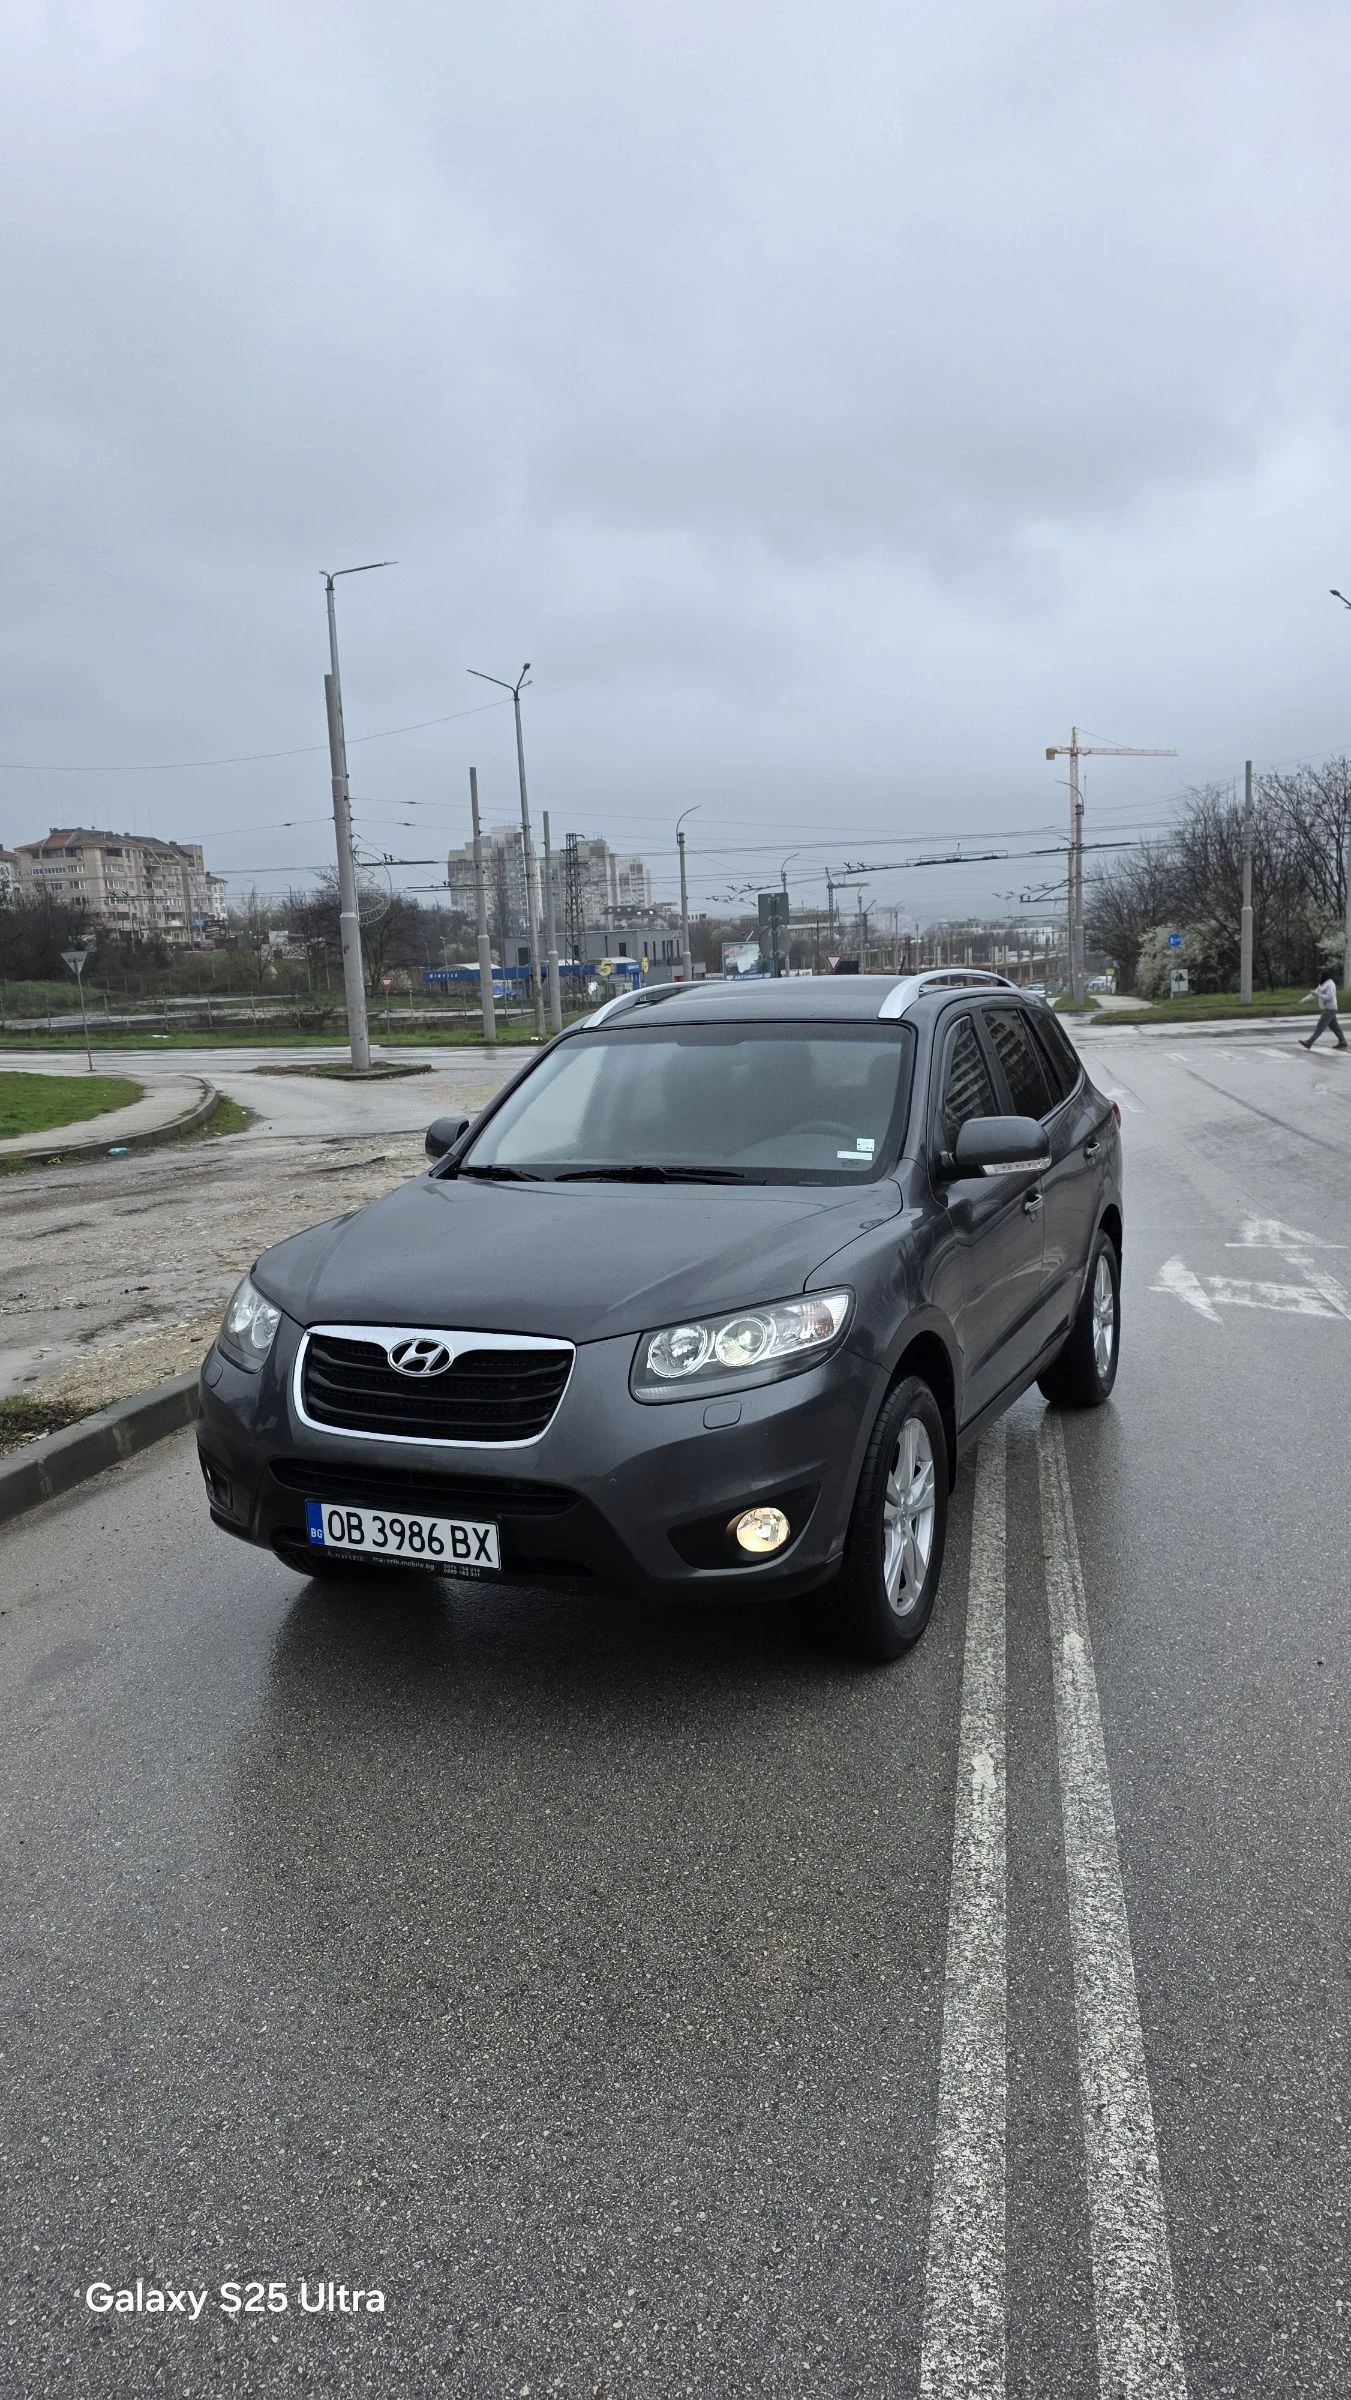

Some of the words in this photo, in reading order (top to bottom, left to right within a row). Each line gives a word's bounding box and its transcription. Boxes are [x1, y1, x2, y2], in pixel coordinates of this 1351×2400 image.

[598, 960, 612, 976] 5
[310, 1527, 323, 1539] BG
[327, 1510, 365, 1545] OB
[372, 1516, 445, 1556] 3986
[450, 1524, 493, 1563] BX
